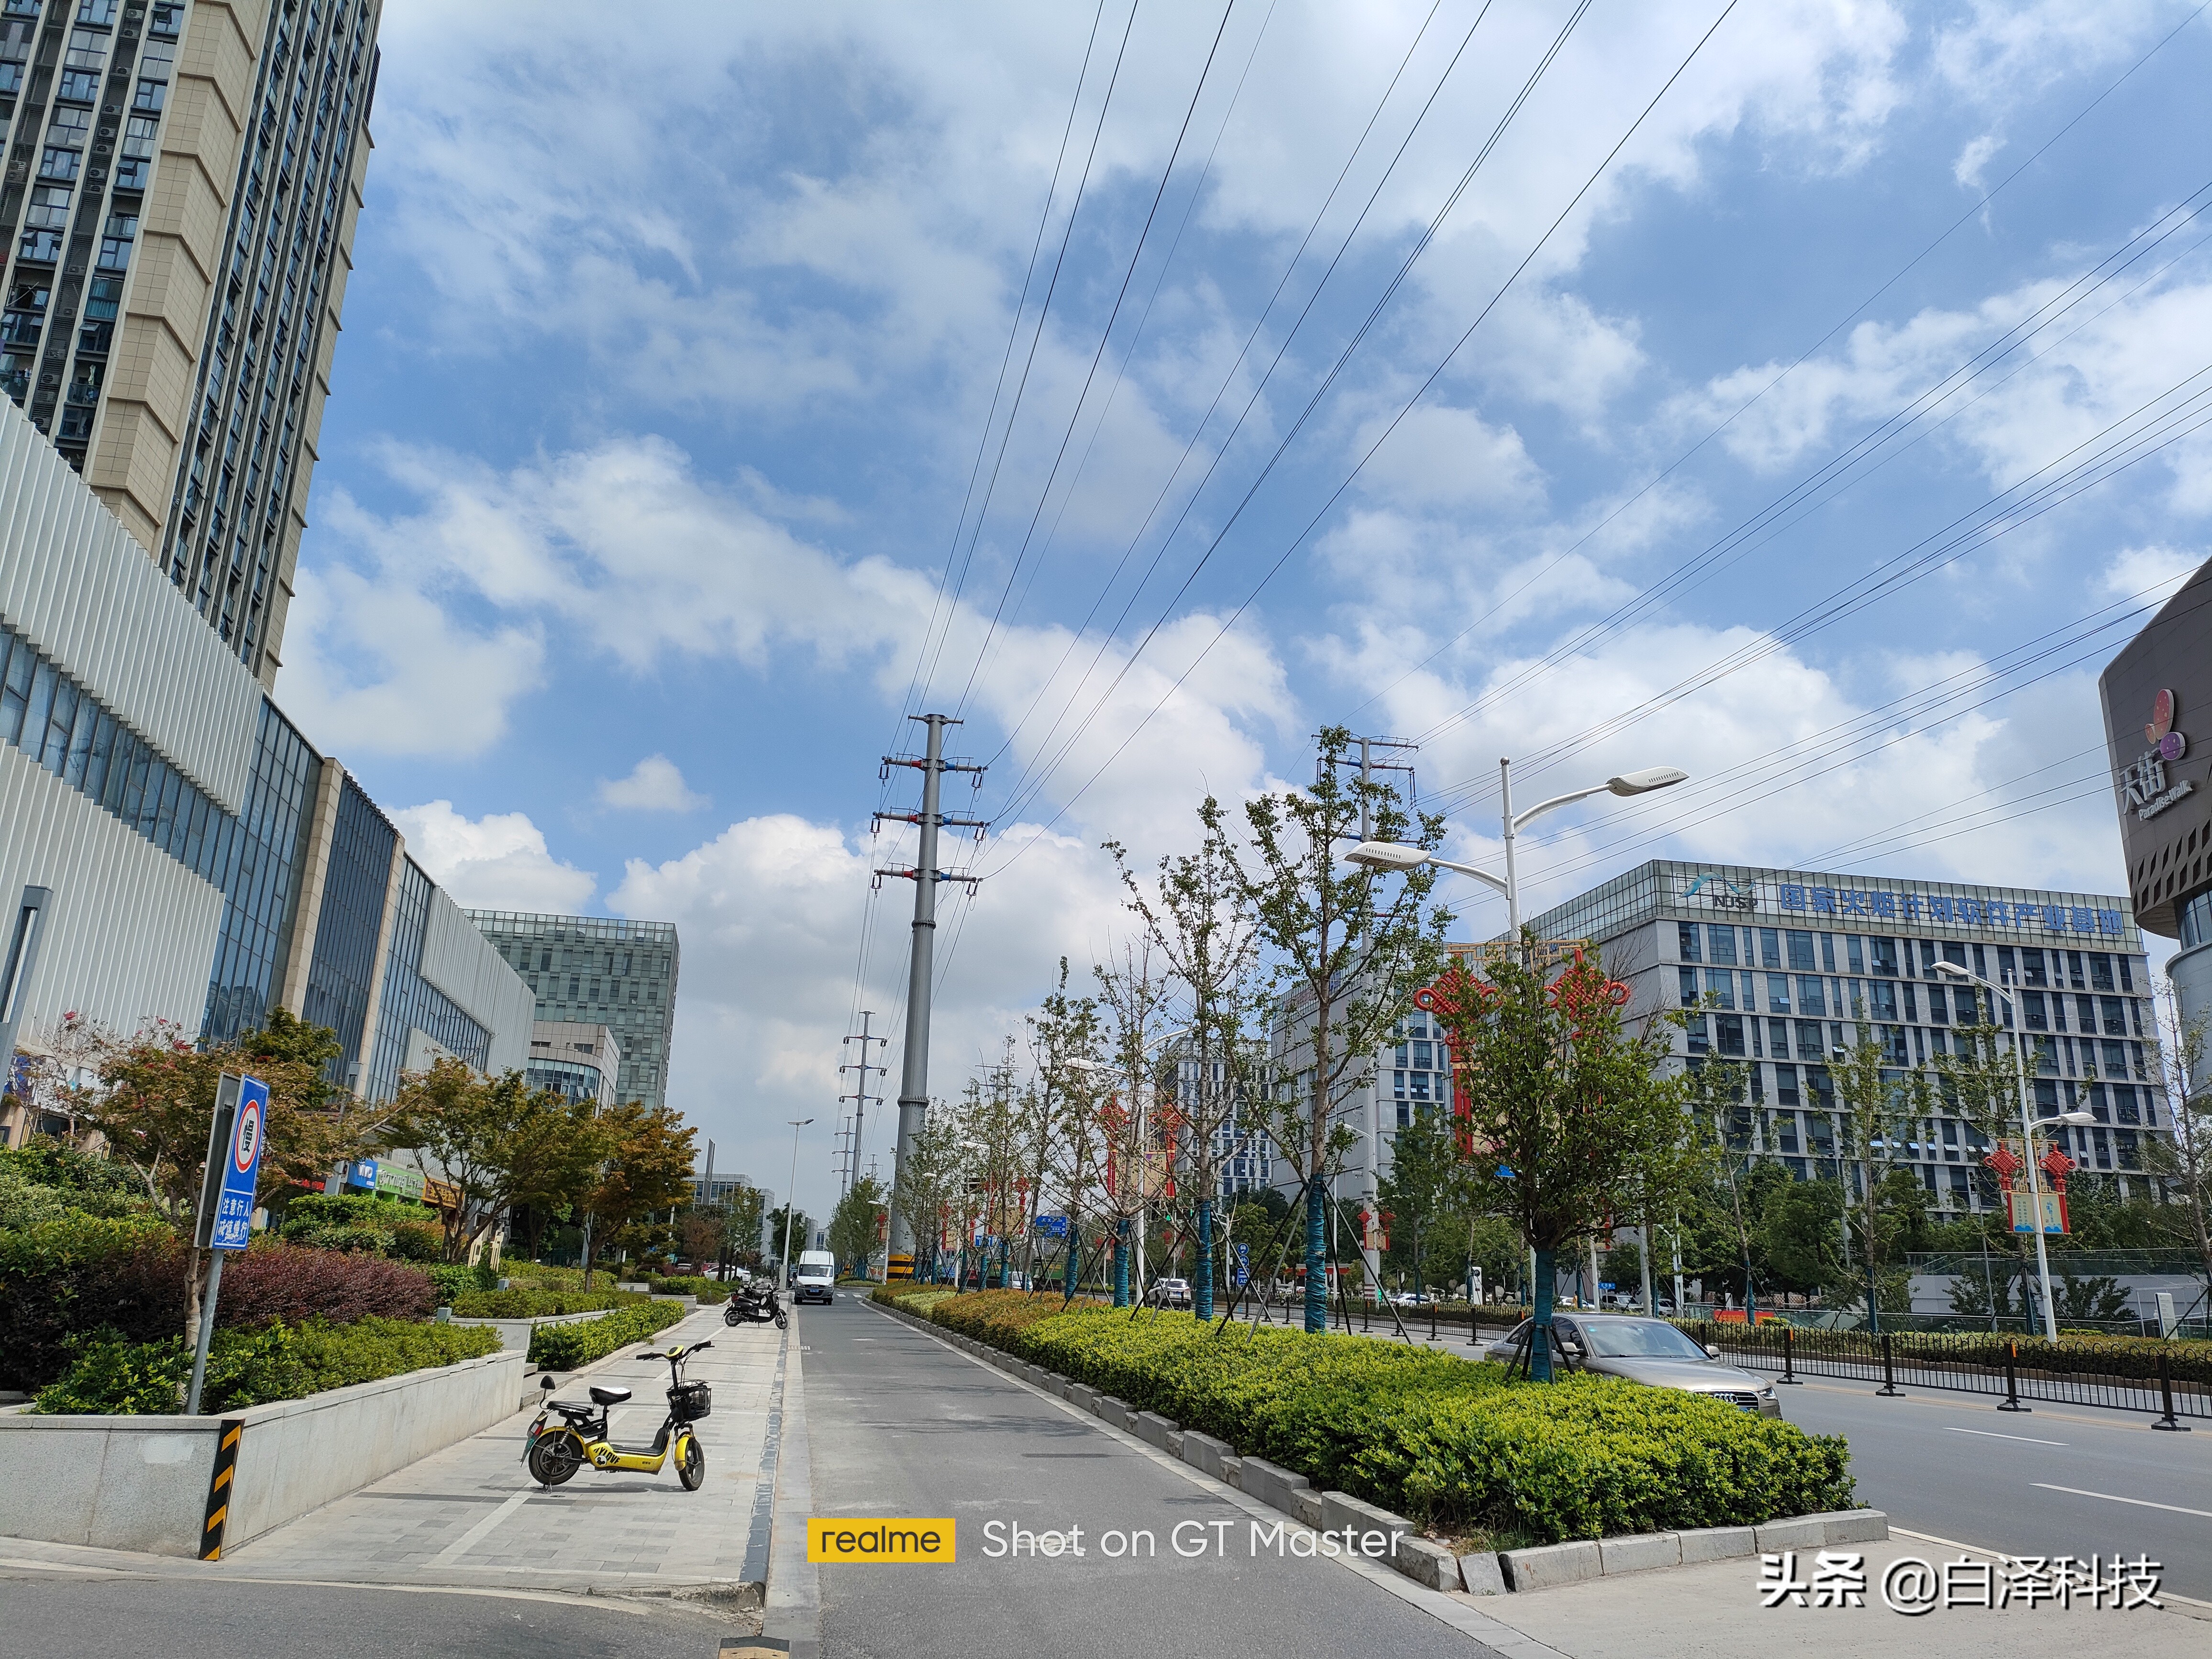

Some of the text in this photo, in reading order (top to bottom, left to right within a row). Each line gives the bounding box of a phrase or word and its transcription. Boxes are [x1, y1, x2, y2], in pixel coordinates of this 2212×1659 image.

[2118, 747, 2166, 815] 天街
[2138, 780, 2192, 821] Paradise Walk
[1714, 894, 1758, 909] NJSP
[1781, 883, 2124, 935] 国家火炬计划软件产业基地
[242, 1118, 254, 1153] 慢
[221, 1197, 249, 1217] 注意行人
[218, 1219, 248, 1240] 减速慢行
